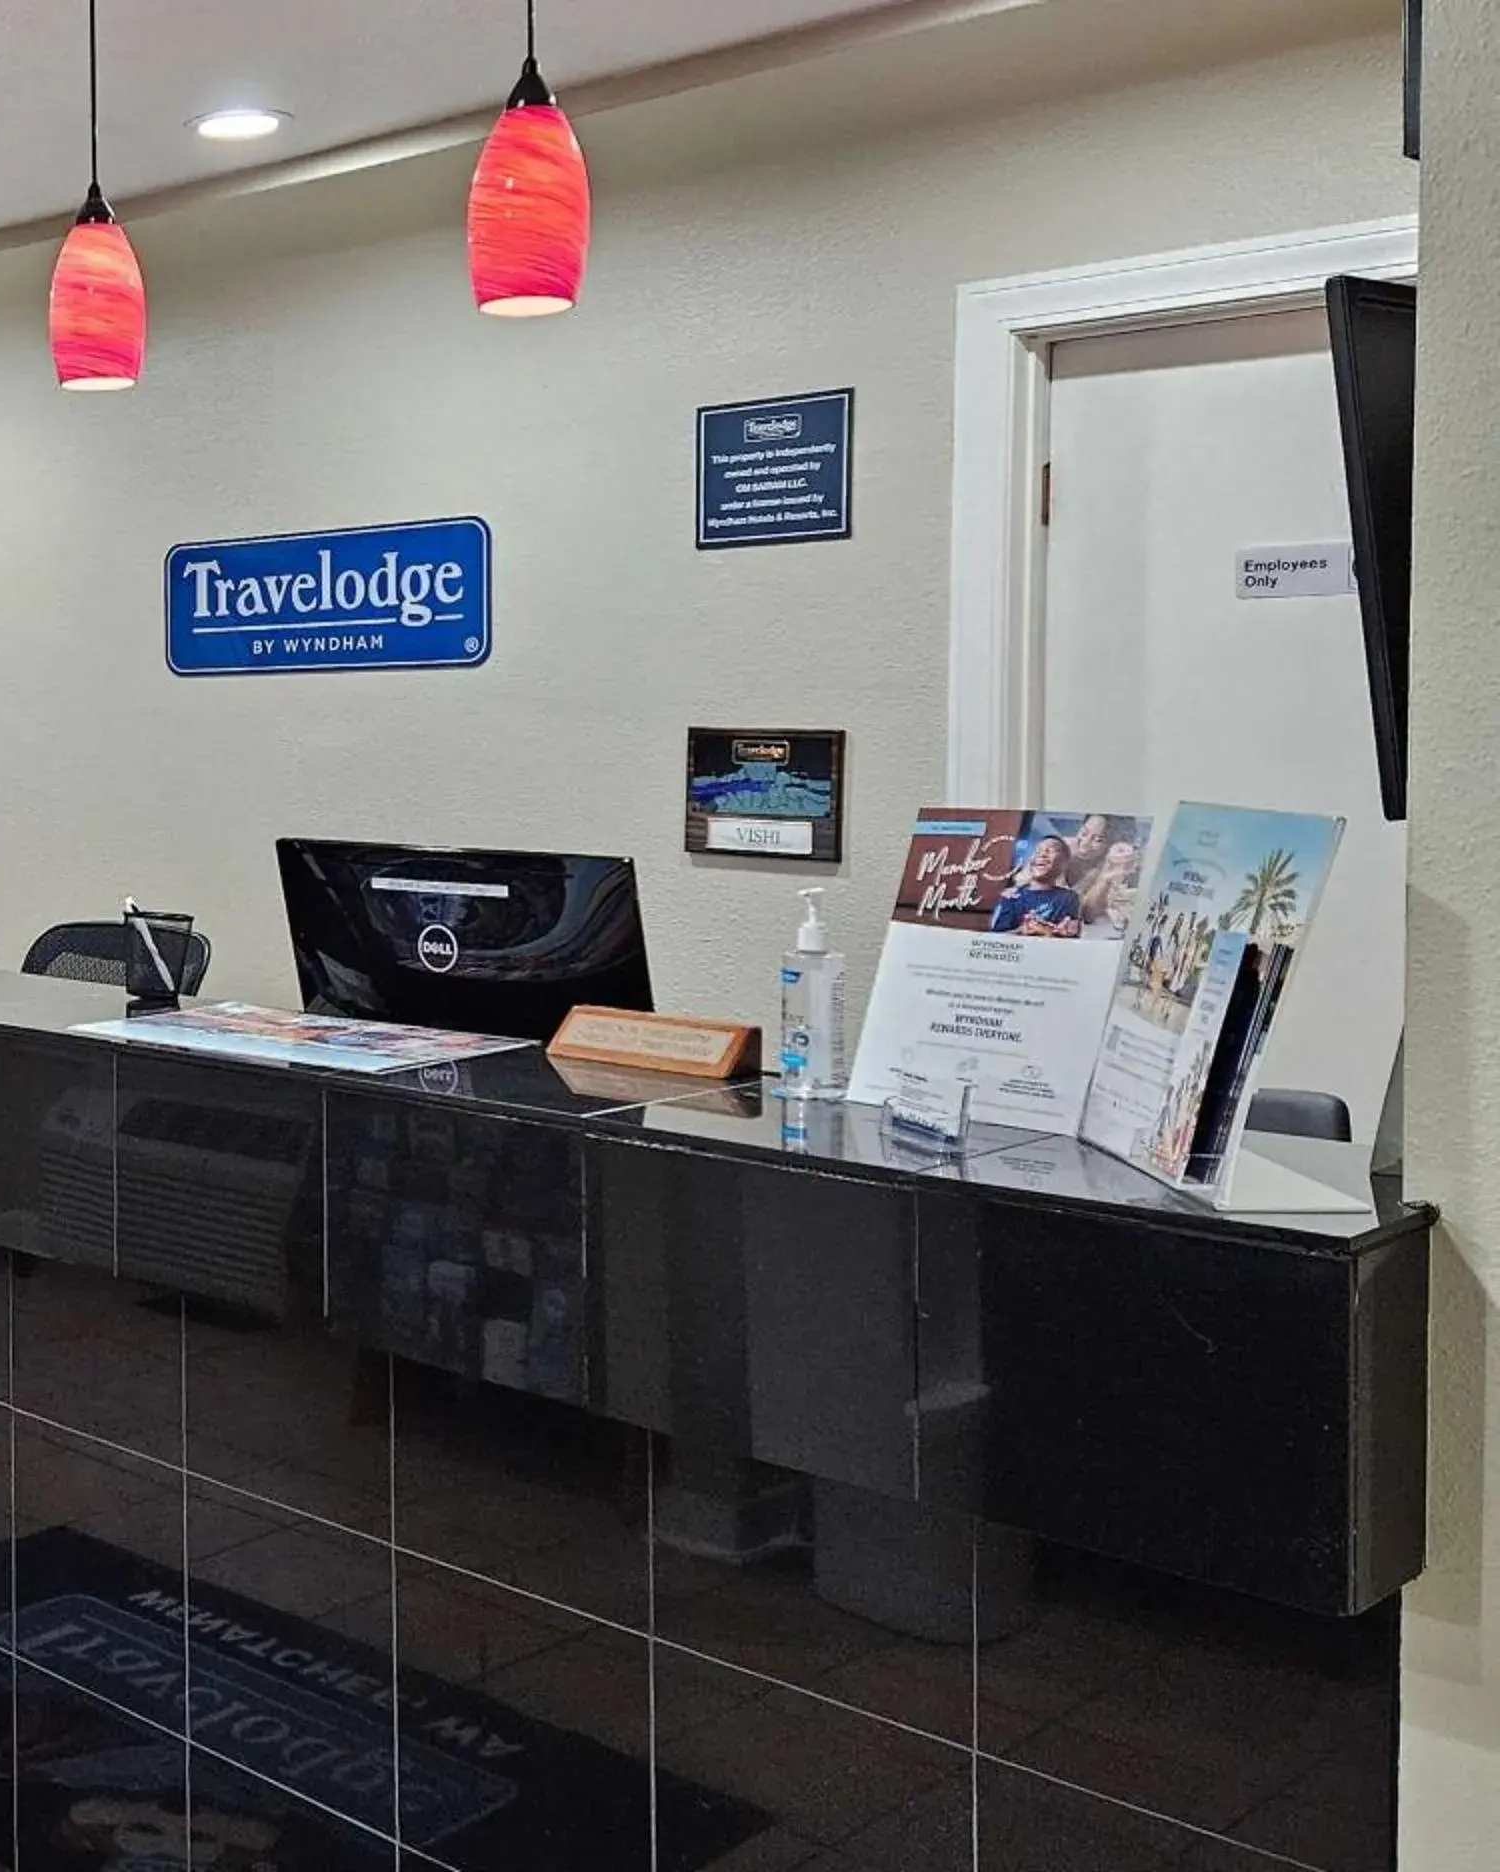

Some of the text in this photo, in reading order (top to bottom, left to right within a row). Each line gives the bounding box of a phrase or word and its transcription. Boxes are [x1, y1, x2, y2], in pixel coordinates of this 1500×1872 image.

[753, 466, 769, 475] and
[809, 461, 821, 471] by
[1243, 558, 1328, 574] Employees
[183, 549, 465, 627] Travelodge
[1244, 575, 1279, 589] Only
[252, 635, 384, 655] BY WYNDHAM
[423, 941, 453, 955] DELL
